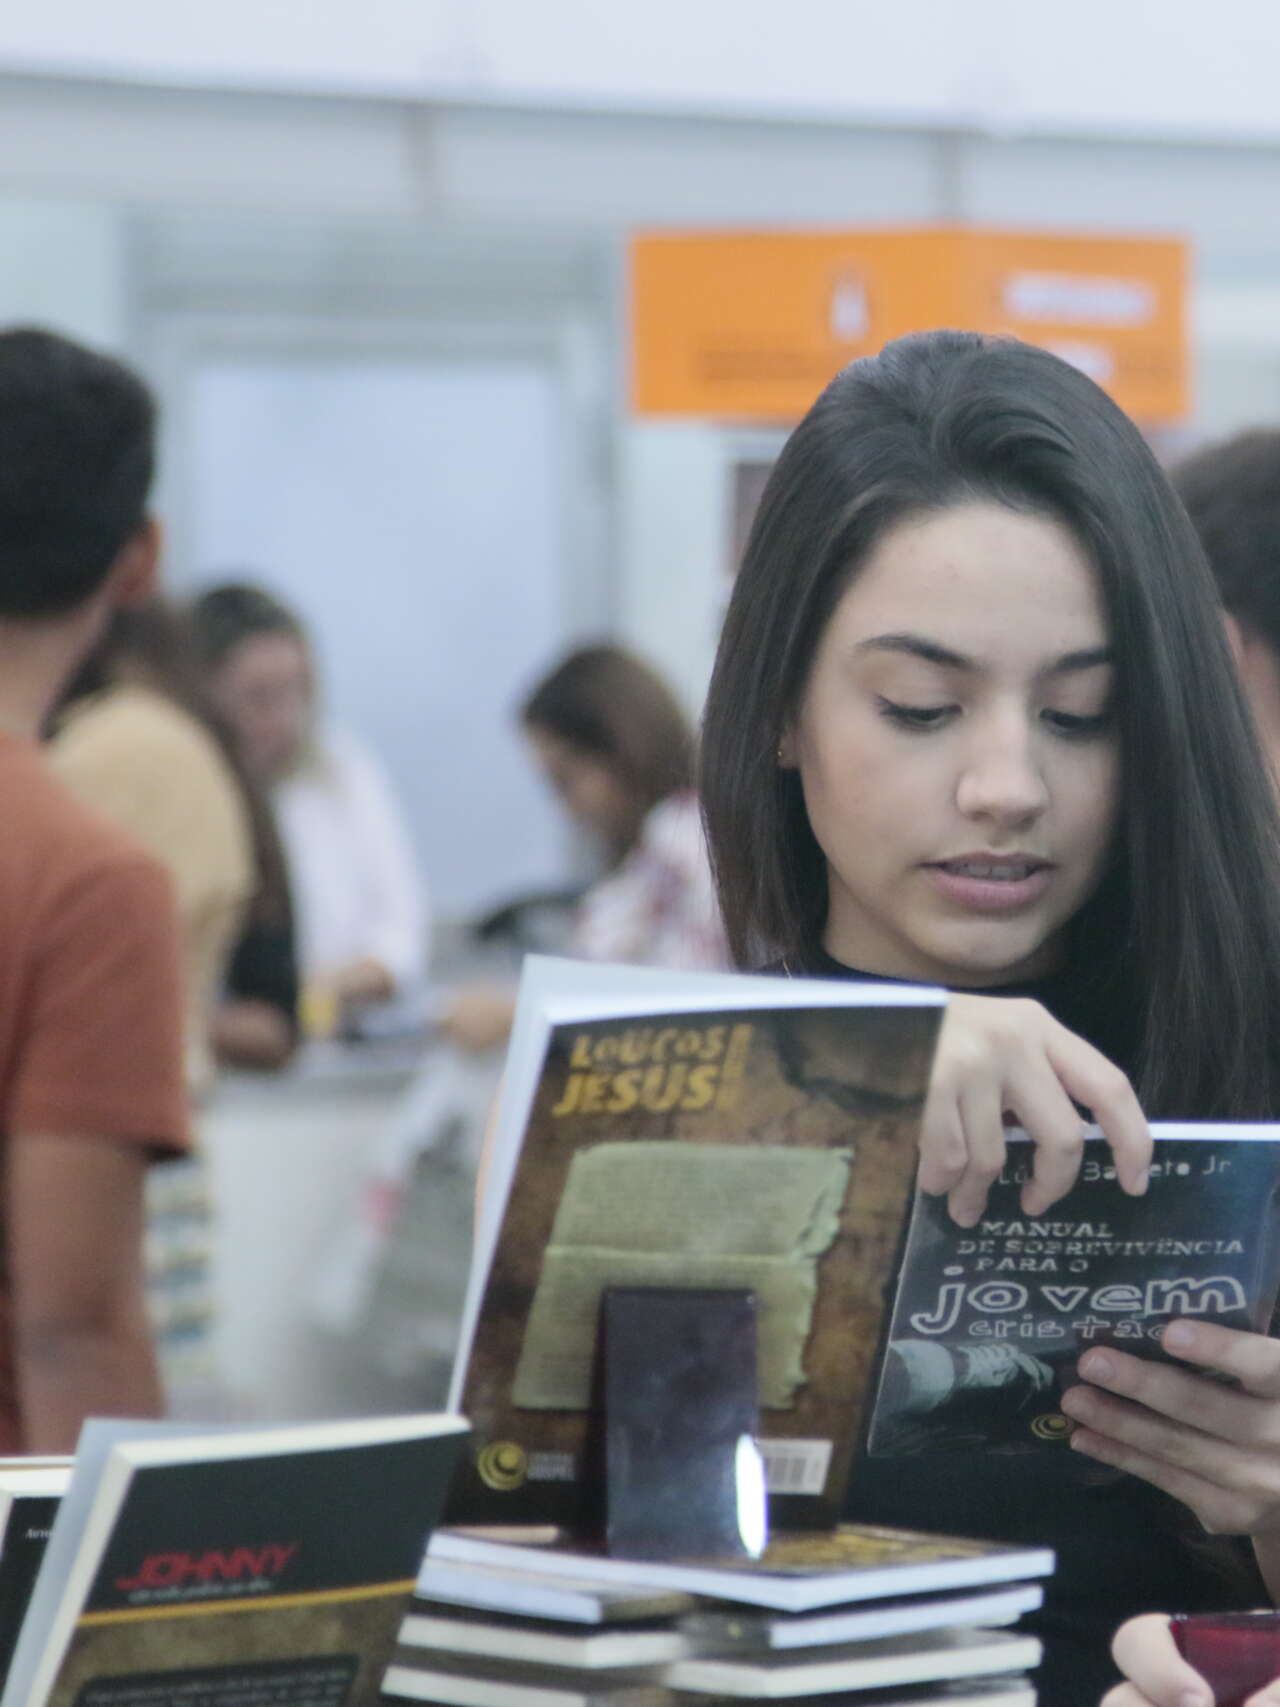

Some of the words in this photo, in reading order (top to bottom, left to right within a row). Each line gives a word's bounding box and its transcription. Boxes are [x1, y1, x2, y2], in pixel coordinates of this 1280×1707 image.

[552, 1062, 720, 1118] JESUS
[1203, 1154, 1231, 1176] Jr
[981, 1221, 1113, 1238] MANUAL
[957, 1240, 994, 1255] DE
[975, 1257, 1058, 1272] PARA
[1069, 1258, 1089, 1272] O
[910, 1264, 1247, 1335] jovem
